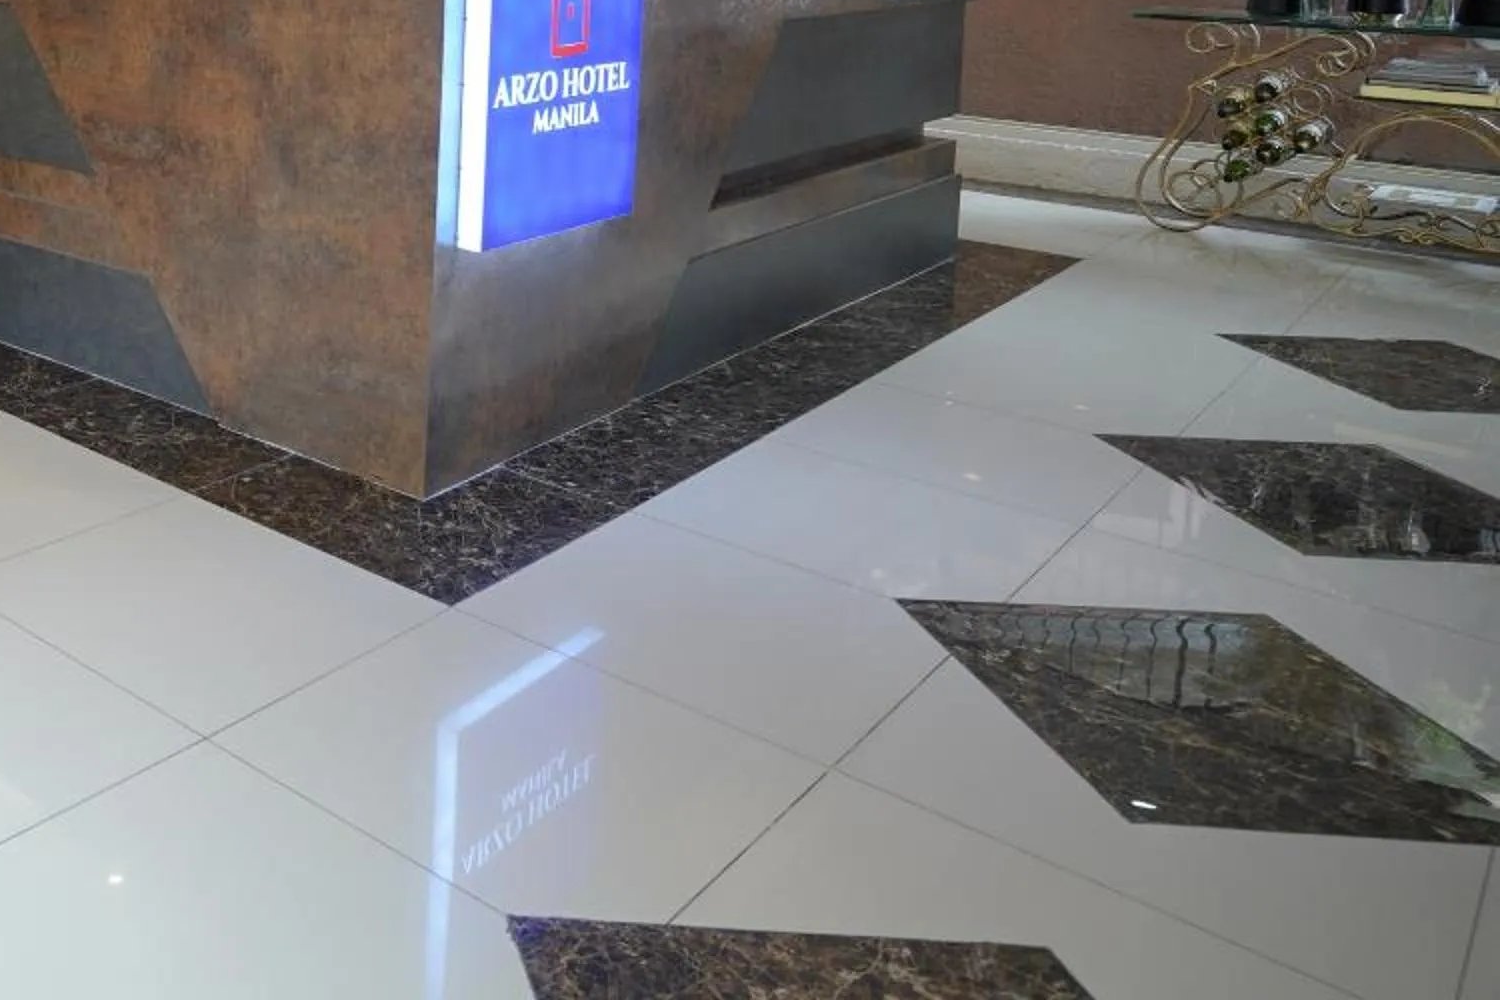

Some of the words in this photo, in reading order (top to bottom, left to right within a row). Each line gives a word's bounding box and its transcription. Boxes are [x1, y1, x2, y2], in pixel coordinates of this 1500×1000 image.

[492, 70, 559, 109] ARZO
[562, 61, 630, 98] HOTEL
[532, 99, 599, 134] MANILA
